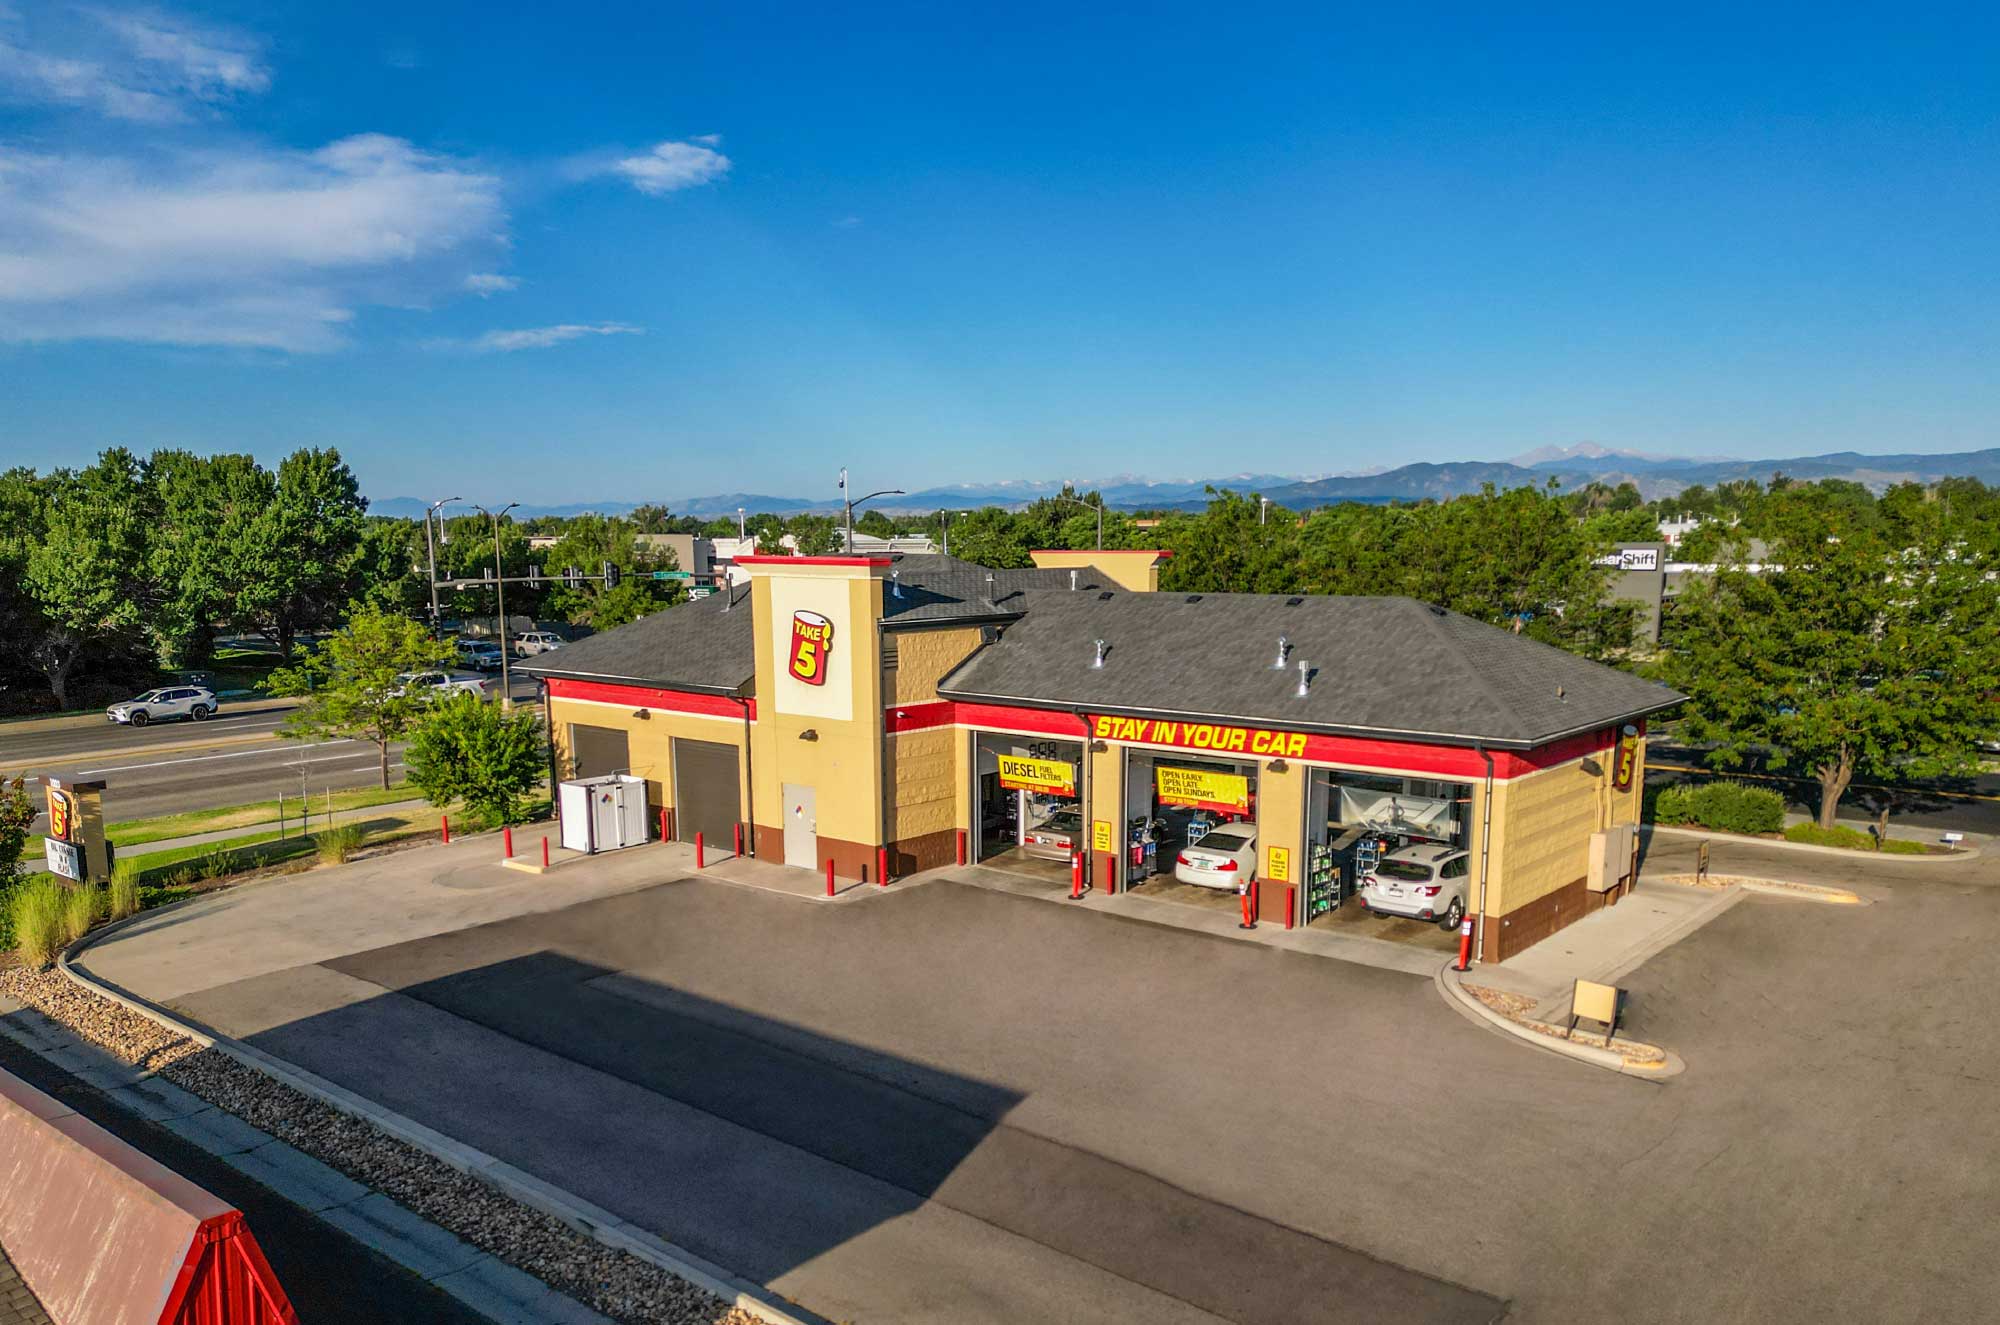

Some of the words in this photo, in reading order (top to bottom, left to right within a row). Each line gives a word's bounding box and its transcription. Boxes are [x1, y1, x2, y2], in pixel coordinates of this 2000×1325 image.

[795, 621, 821, 641] TAKE
[794, 641, 816, 678] 5
[1096, 716, 1149, 741] STAY
[1151, 721, 1177, 743] IN
[1183, 724, 1247, 751] YOUR
[1252, 730, 1308, 757] CAR
[1003, 761, 1040, 779] DIESEL
[1040, 766, 1053, 774] FUEL
[1040, 773, 1062, 781] FILTERS
[1162, 770, 1180, 779] OPEN
[1618, 752, 1632, 785] 5
[1163, 778, 1181, 787] OPEN
[1164, 786, 1182, 795] OPEN
[53, 811, 63, 835] 5
